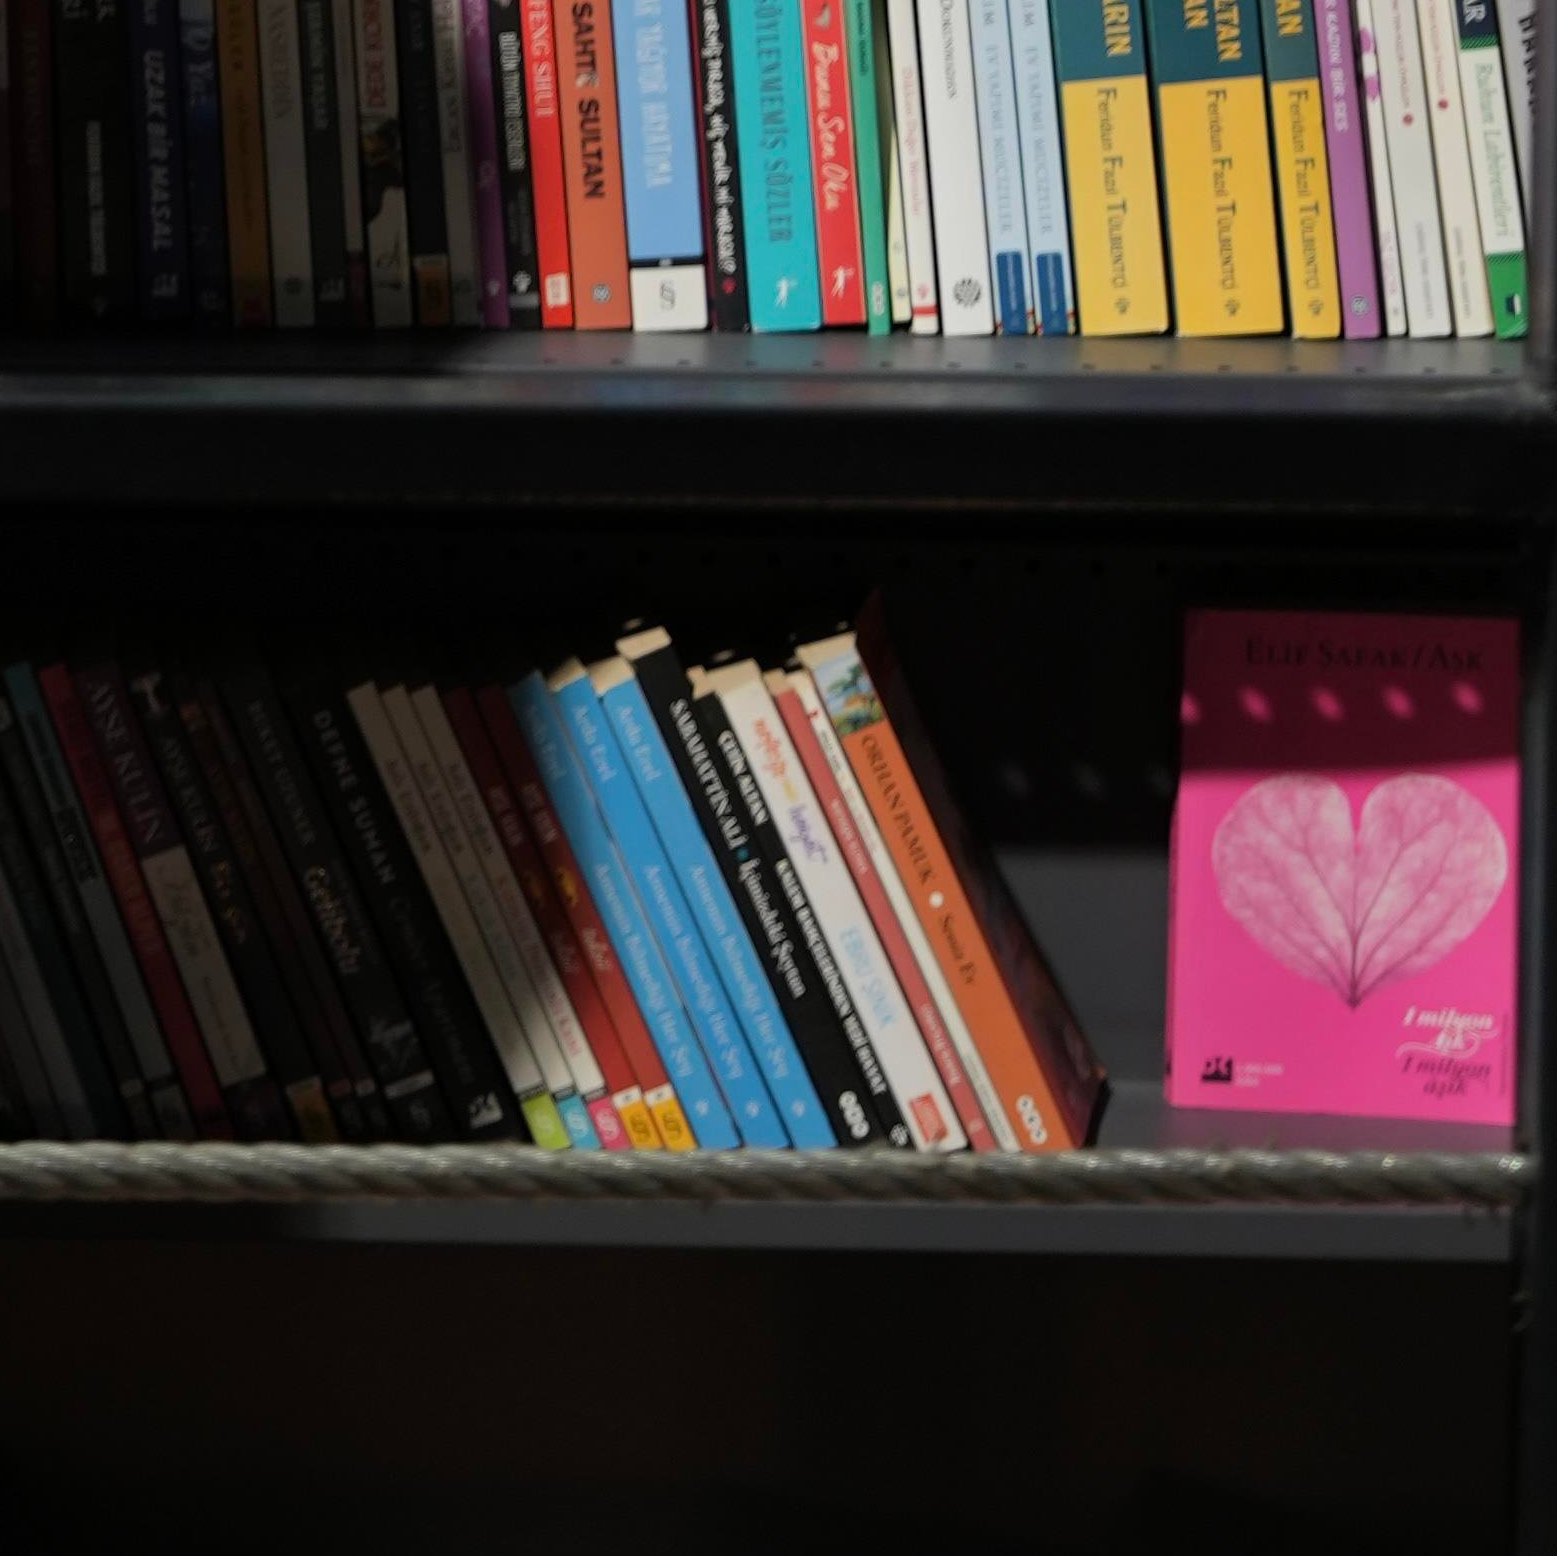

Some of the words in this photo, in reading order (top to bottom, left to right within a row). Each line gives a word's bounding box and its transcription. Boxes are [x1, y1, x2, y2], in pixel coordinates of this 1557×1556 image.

[578, 99, 605, 199] SULTAN
[766, 157, 794, 243] SÖZLER
[859, 735, 902, 809] ORHAN
[893, 810, 933, 885] PAMUK
